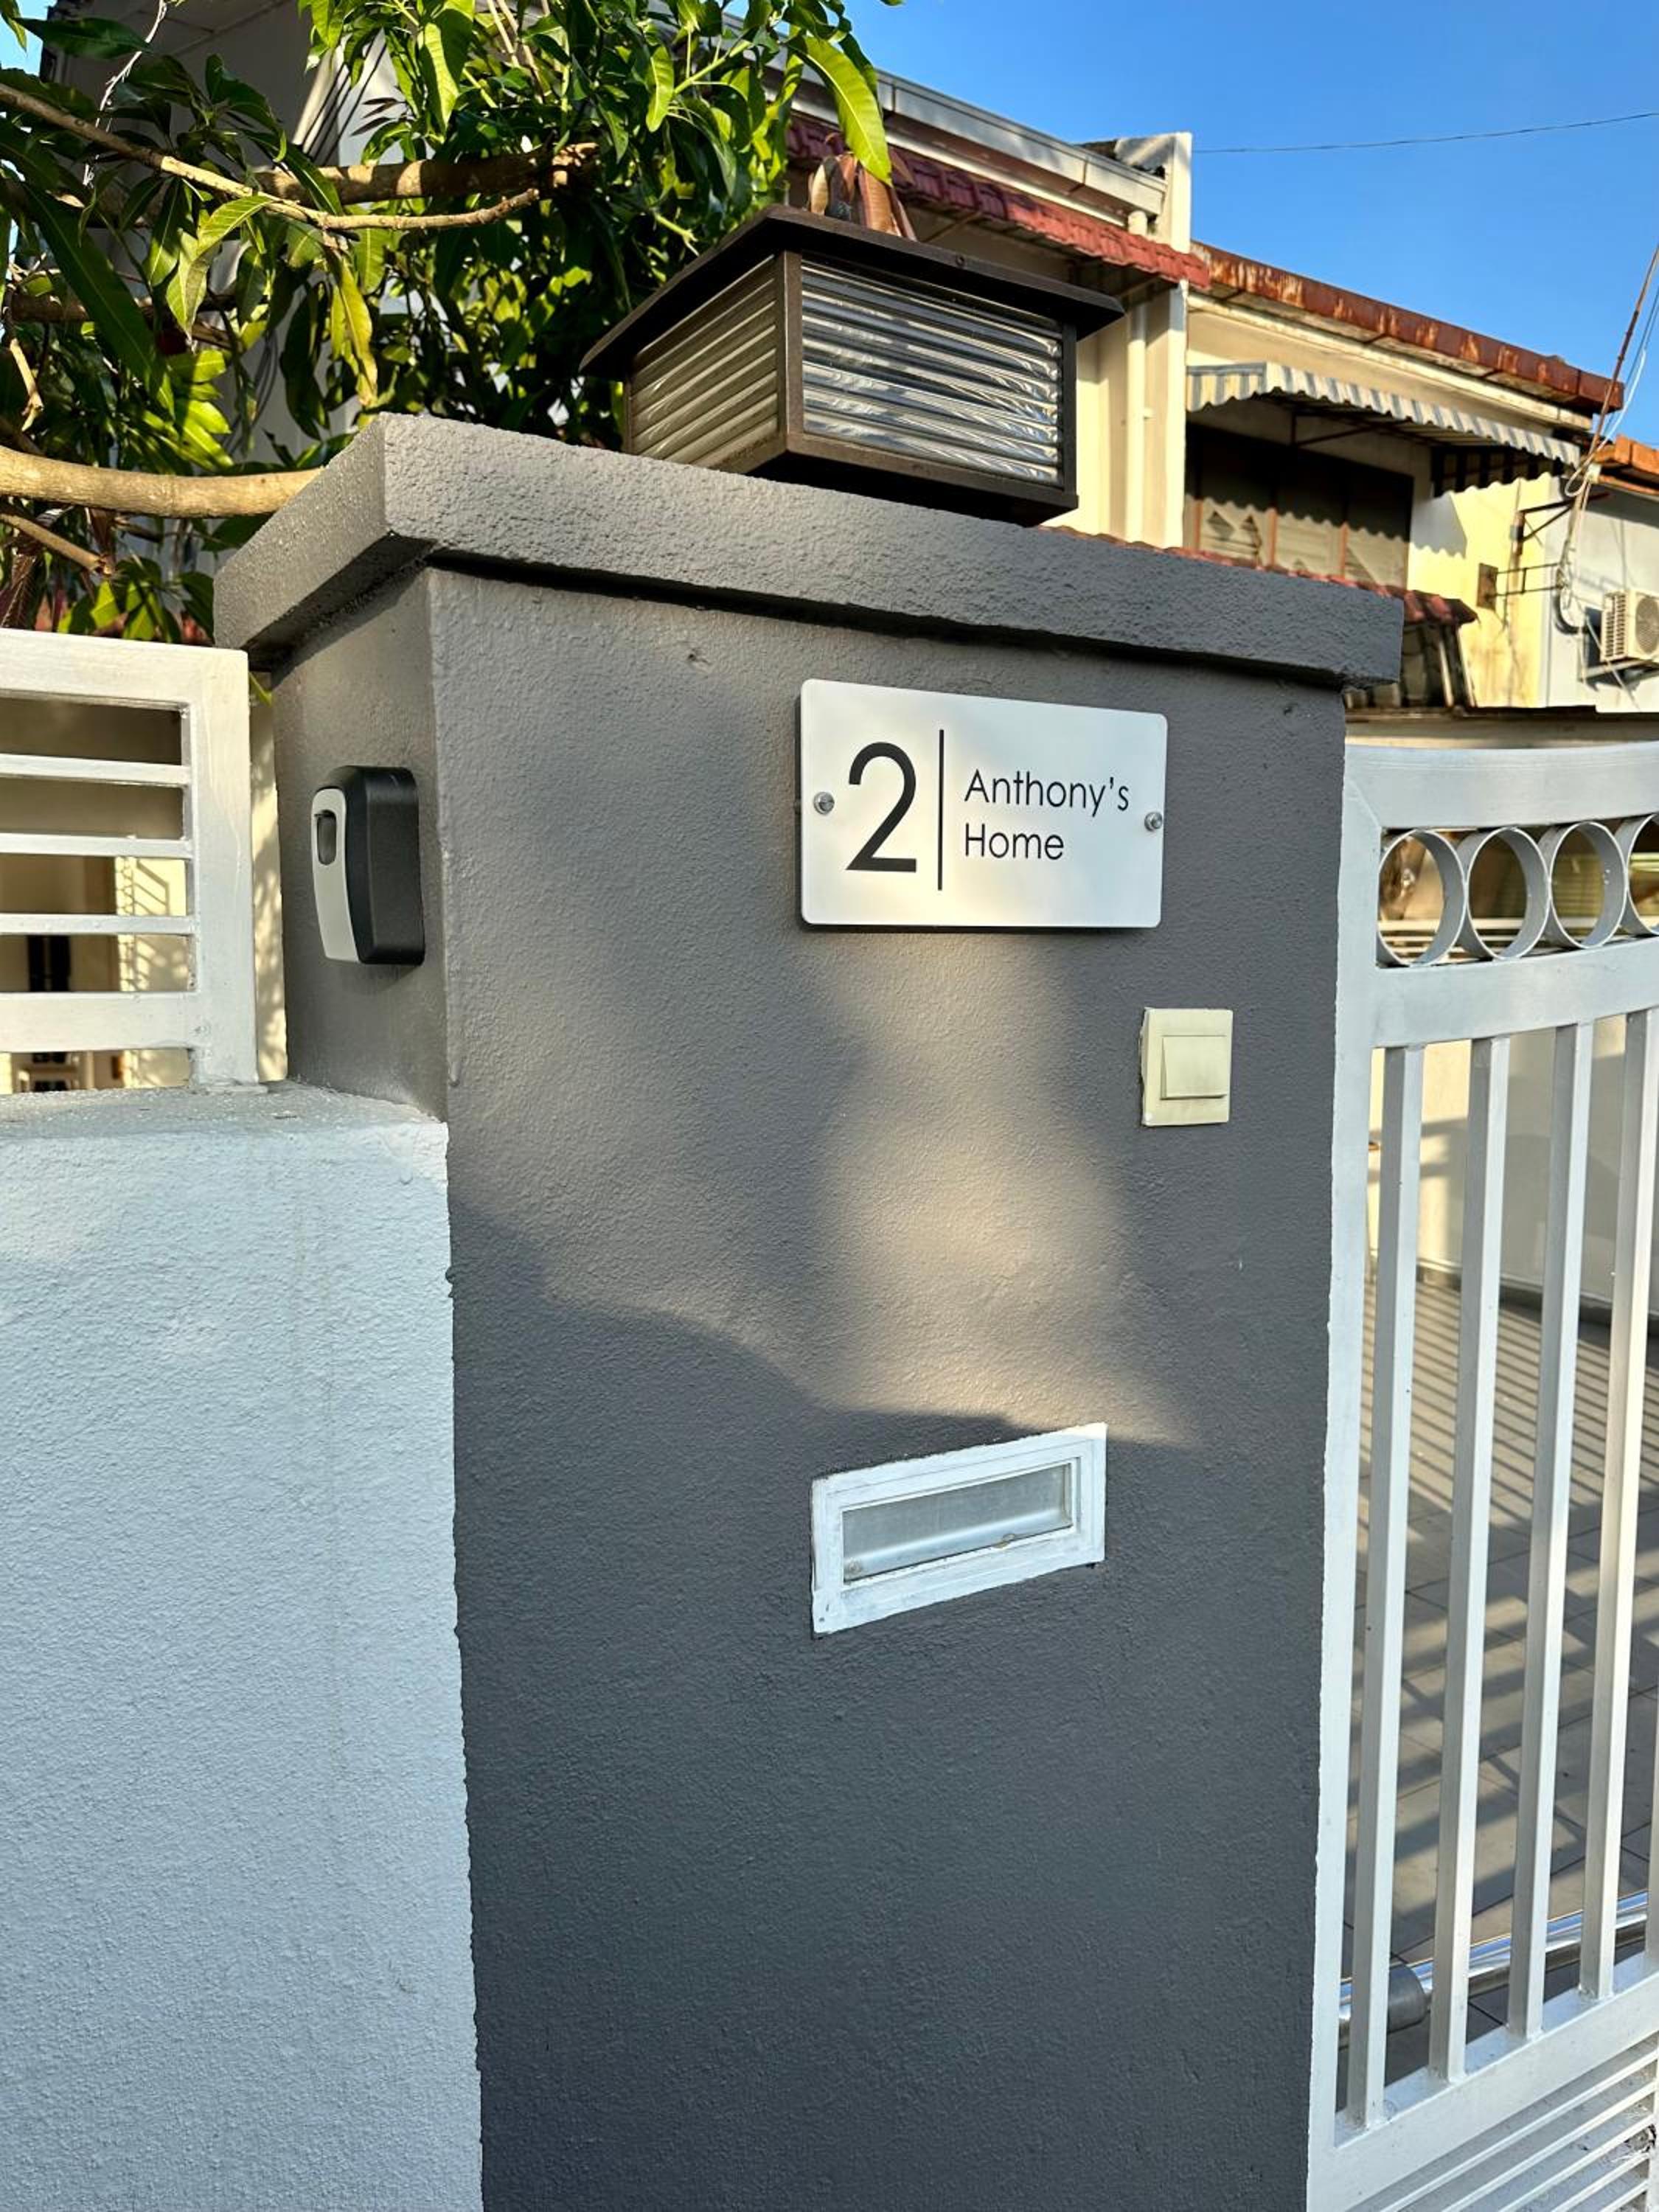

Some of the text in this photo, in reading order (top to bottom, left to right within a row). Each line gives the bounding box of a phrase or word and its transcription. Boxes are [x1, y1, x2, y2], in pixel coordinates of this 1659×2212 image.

[846, 742, 917, 873] 2
[964, 769, 1130, 818] Anthony's
[965, 823, 1065, 860] Home
